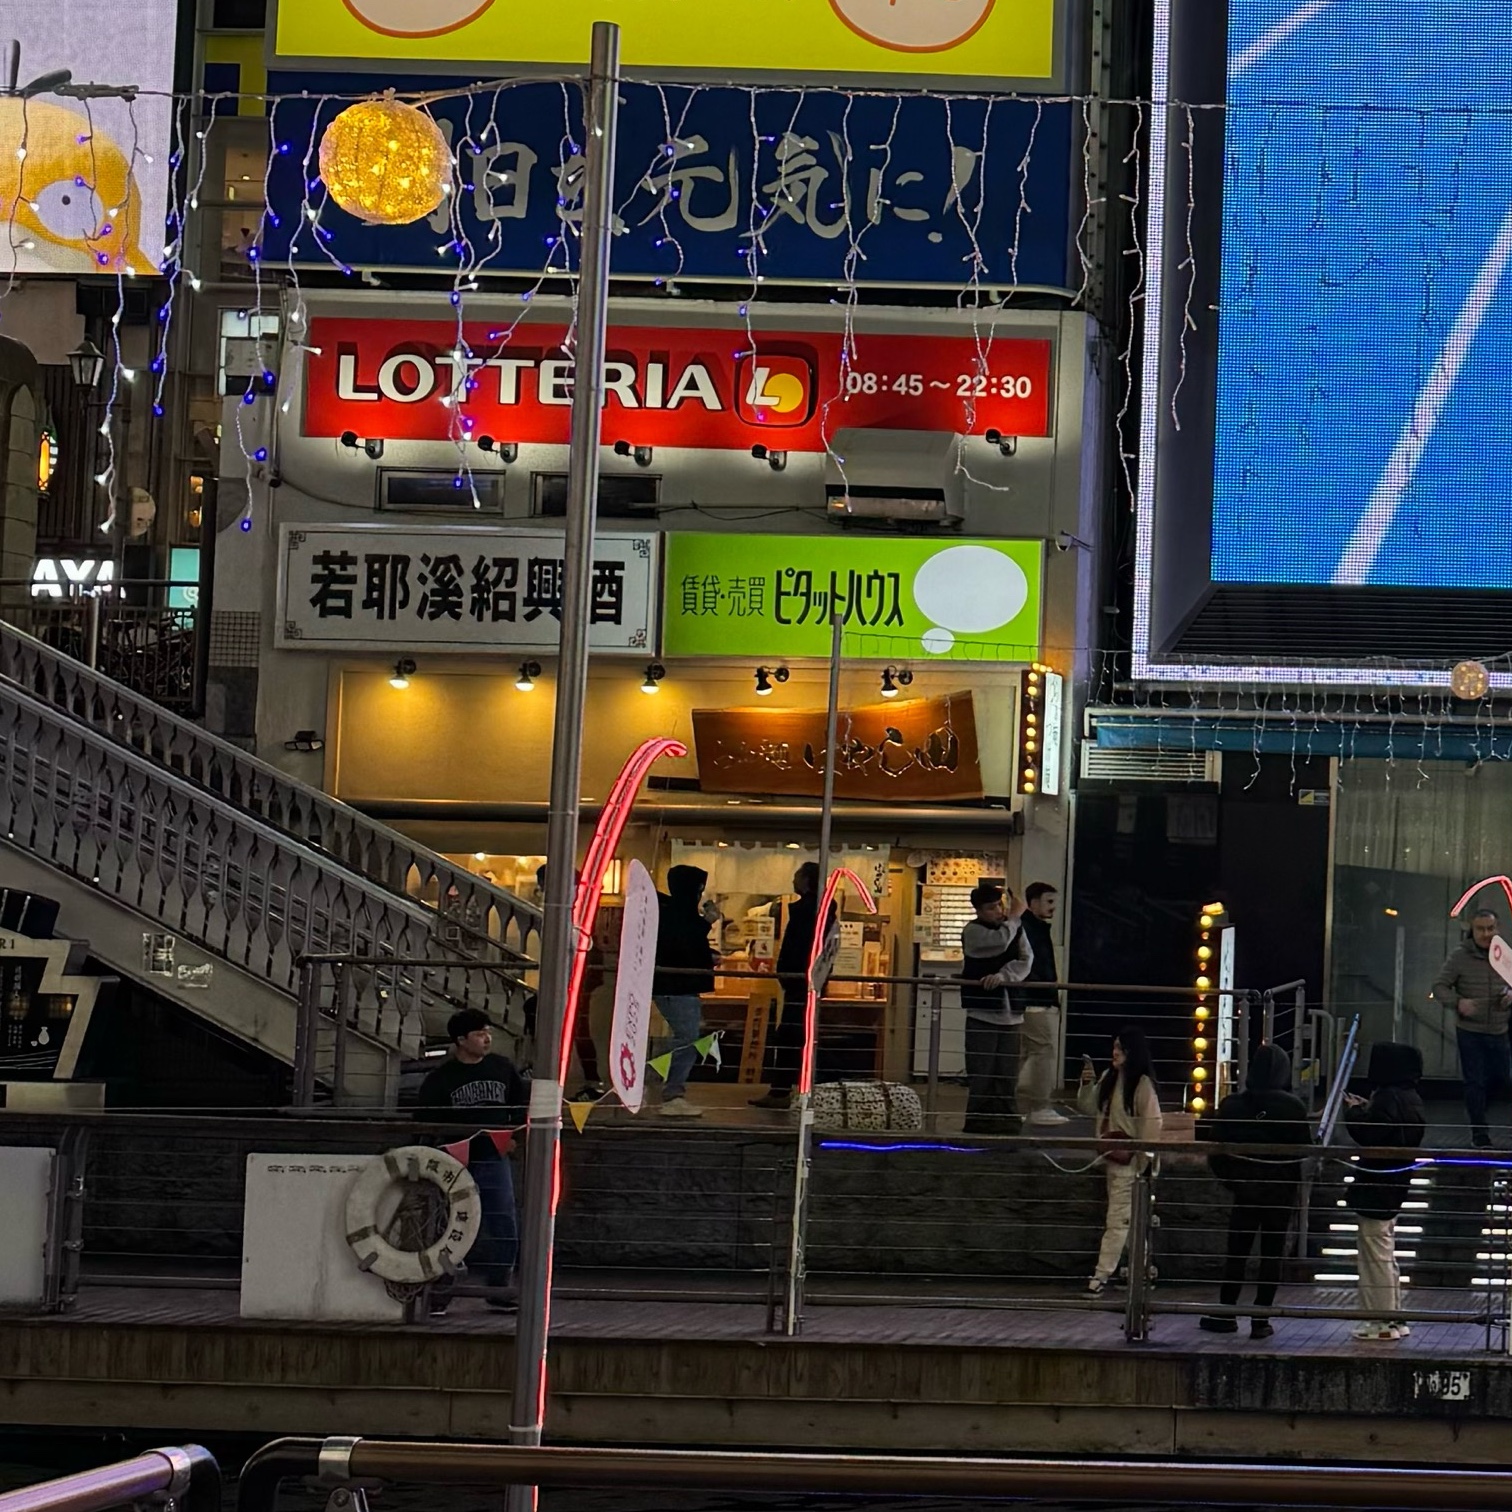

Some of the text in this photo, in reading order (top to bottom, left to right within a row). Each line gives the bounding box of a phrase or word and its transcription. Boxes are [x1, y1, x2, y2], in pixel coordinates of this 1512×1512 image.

[337, 353, 722, 411] LOTTERIA
[681, 567, 905, 627] 賃貸・売買 ピタットハウス
